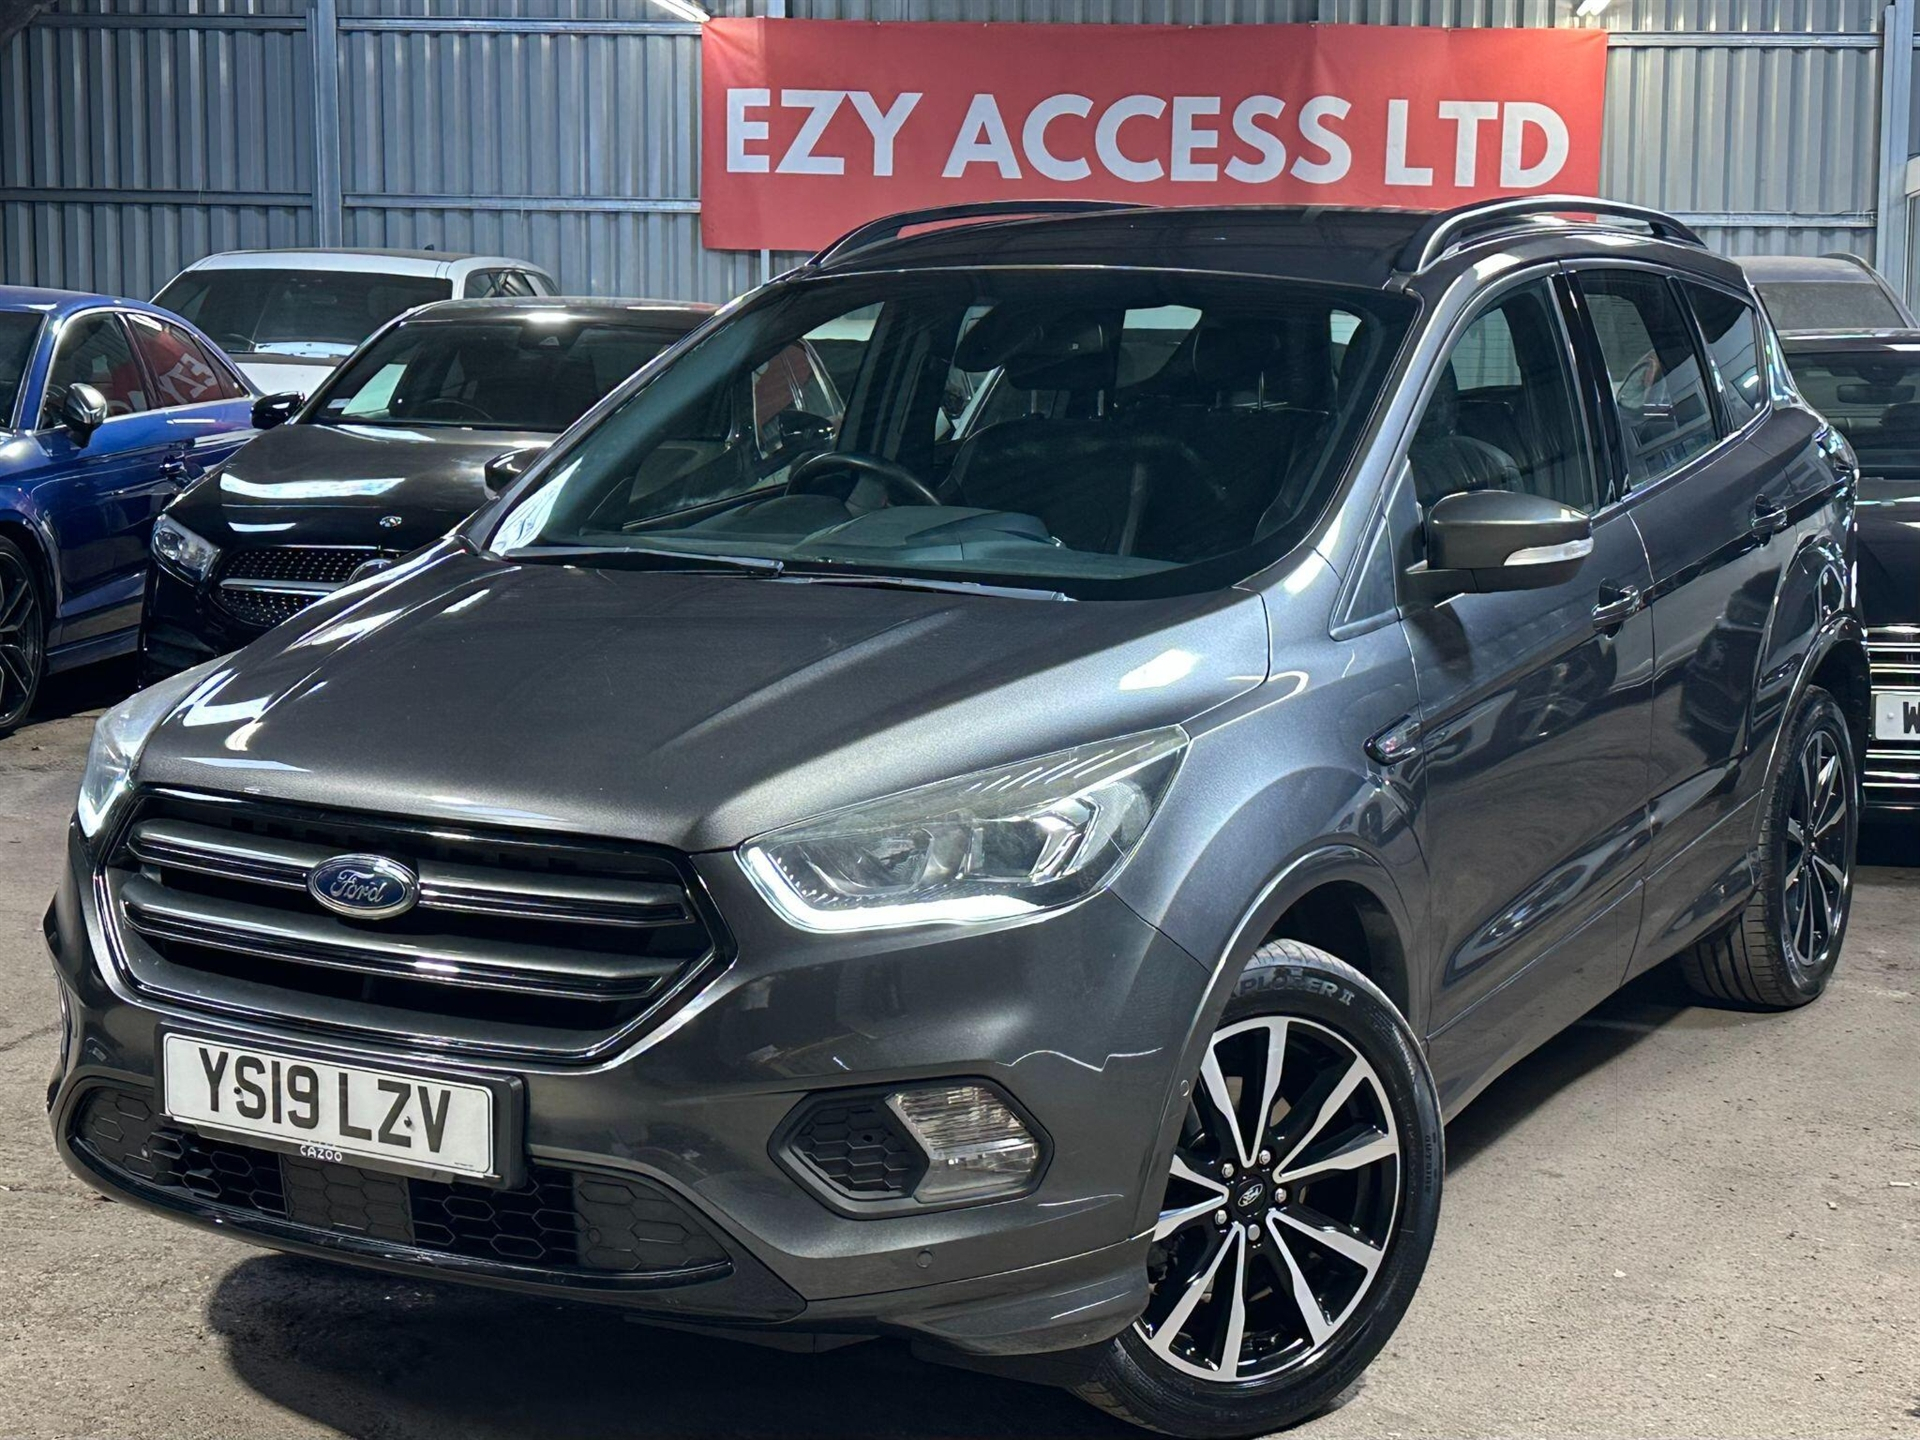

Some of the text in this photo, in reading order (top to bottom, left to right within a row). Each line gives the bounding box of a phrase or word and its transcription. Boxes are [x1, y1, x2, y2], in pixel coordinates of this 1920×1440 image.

[727, 88, 1569, 188] EZY ACCESS LTD
[329, 869, 388, 903] Ford
[199, 1047, 451, 1153] YS19 LZV
[300, 1145, 343, 1162] CAZOO
